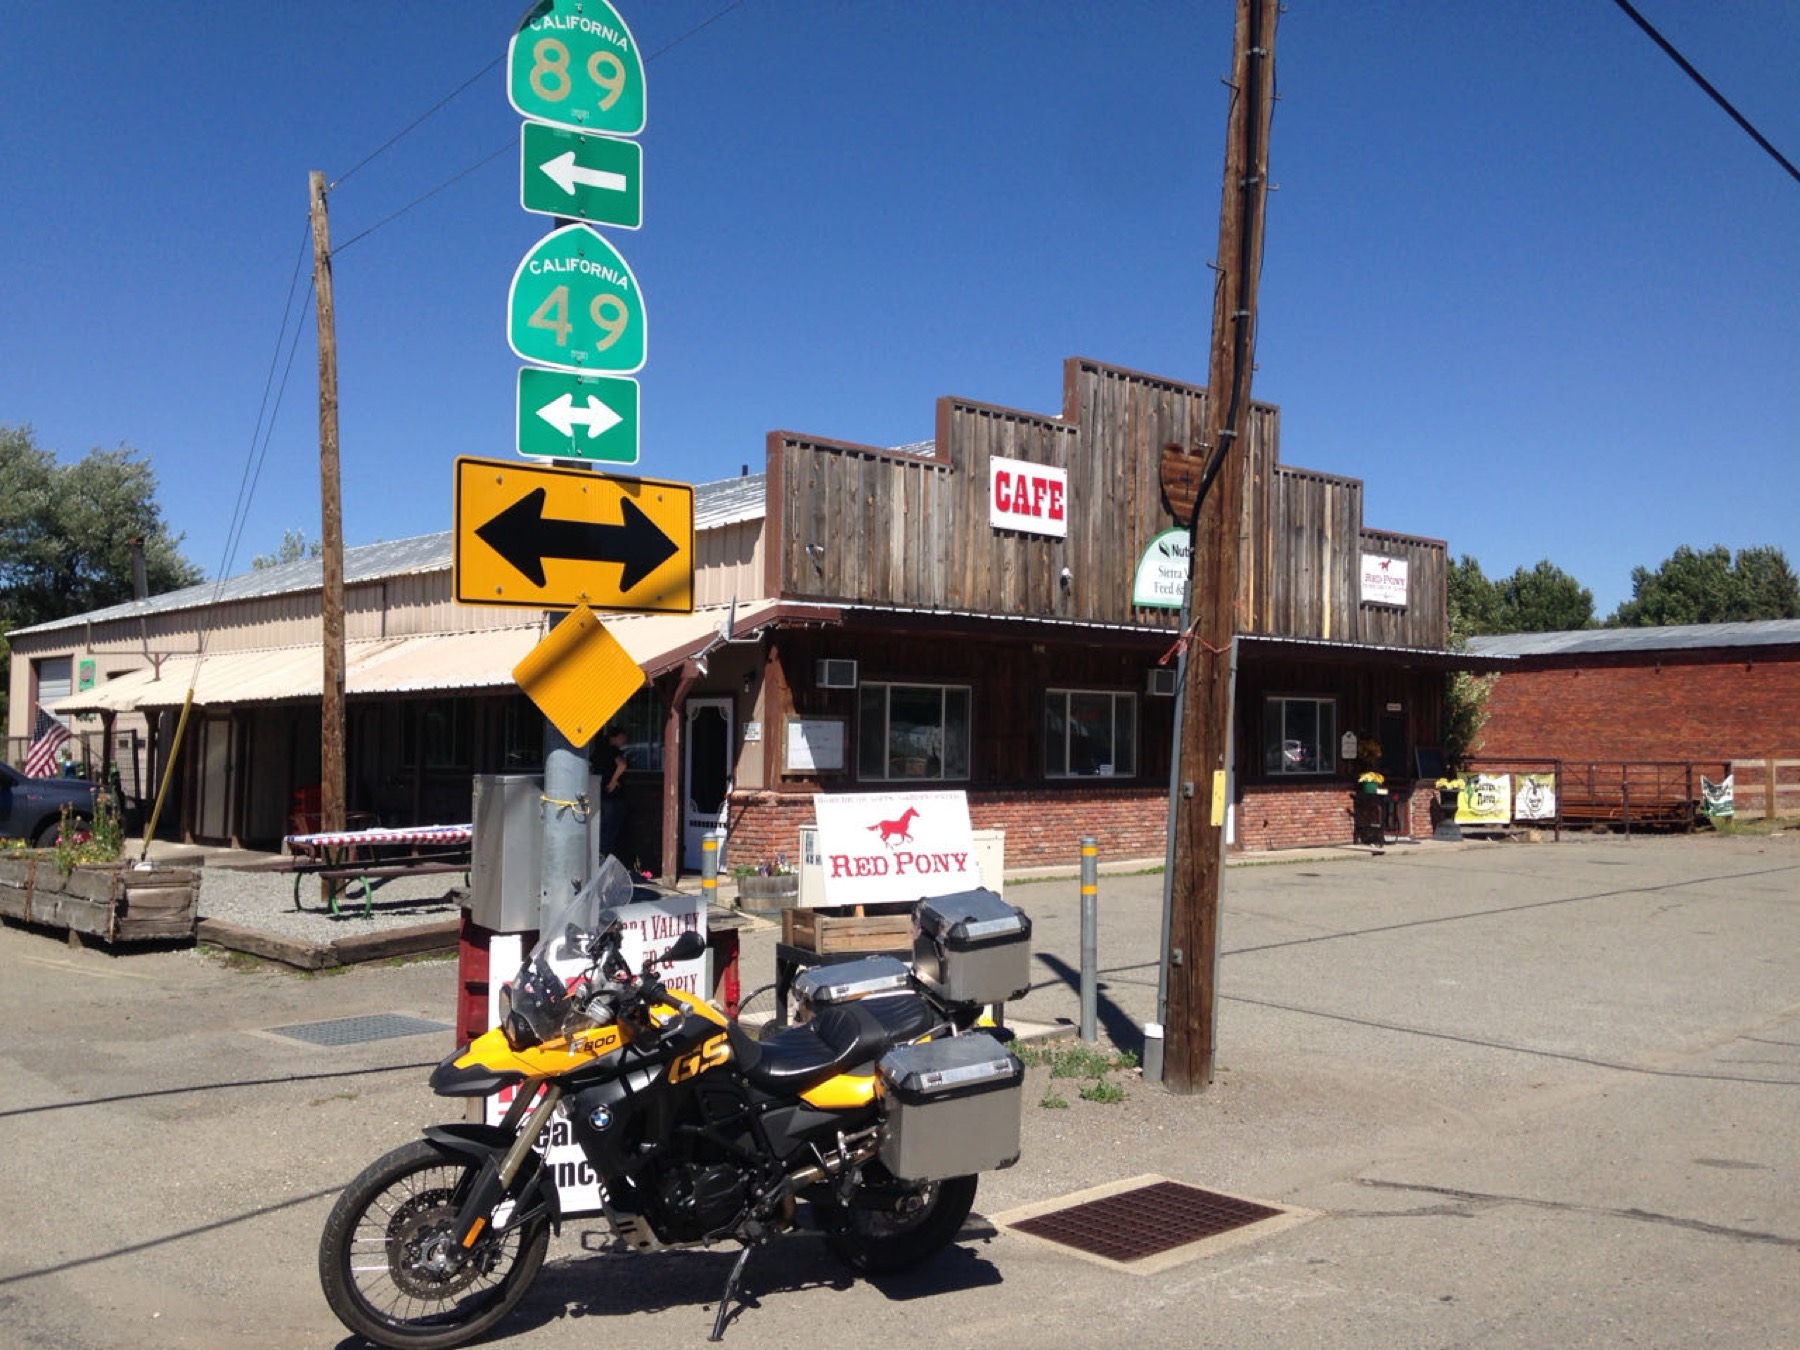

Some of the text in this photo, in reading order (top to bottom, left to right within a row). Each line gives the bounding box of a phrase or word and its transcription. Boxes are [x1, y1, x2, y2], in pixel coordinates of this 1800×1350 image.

[529, 15, 628, 52] CALIFORNIA
[529, 38, 626, 111] 89
[529, 257, 628, 290] CALIFORNIA
[526, 284, 629, 351] 49
[995, 470, 1063, 520] CAFE
[829, 853, 889, 878] RED
[893, 851, 968, 876] PONY
[651, 911, 700, 941] VALLEY
[668, 1032, 730, 1085] GS
